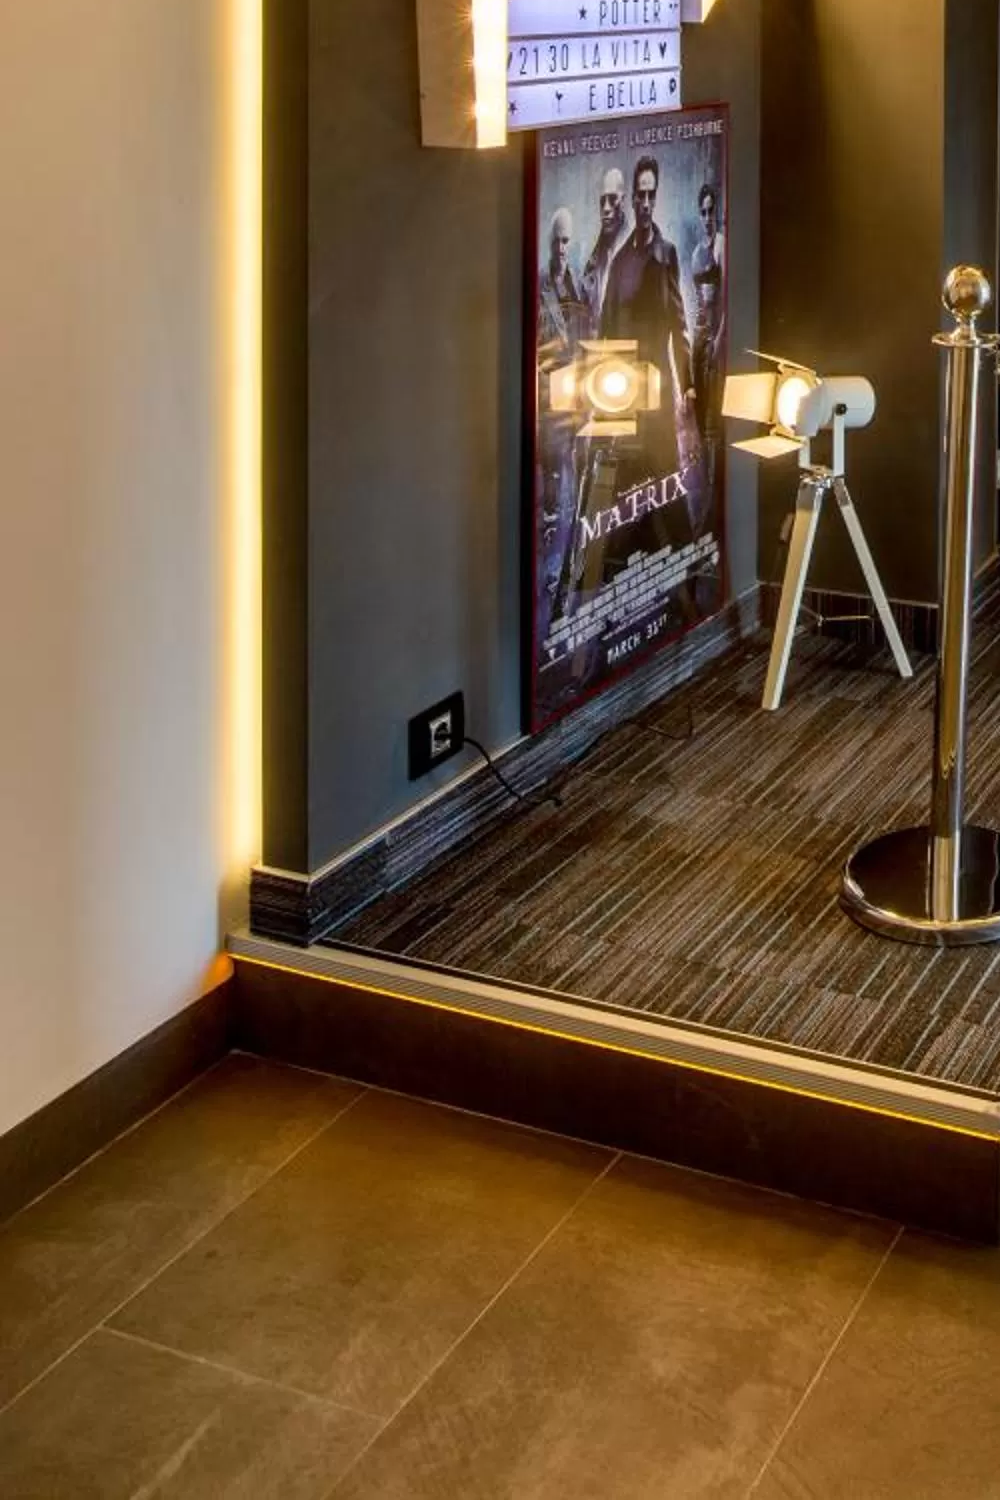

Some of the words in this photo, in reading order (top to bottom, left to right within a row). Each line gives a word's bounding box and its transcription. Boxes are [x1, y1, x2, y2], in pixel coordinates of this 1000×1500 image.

[599, 0, 661, 26] POTTER
[519, 43, 570, 76] 2130
[582, 41, 601, 69] LA
[611, 39, 651, 67] VITA
[589, 84, 597, 111] E
[607, 79, 657, 109] BELLA
[580, 467, 689, 549] MATRIX
